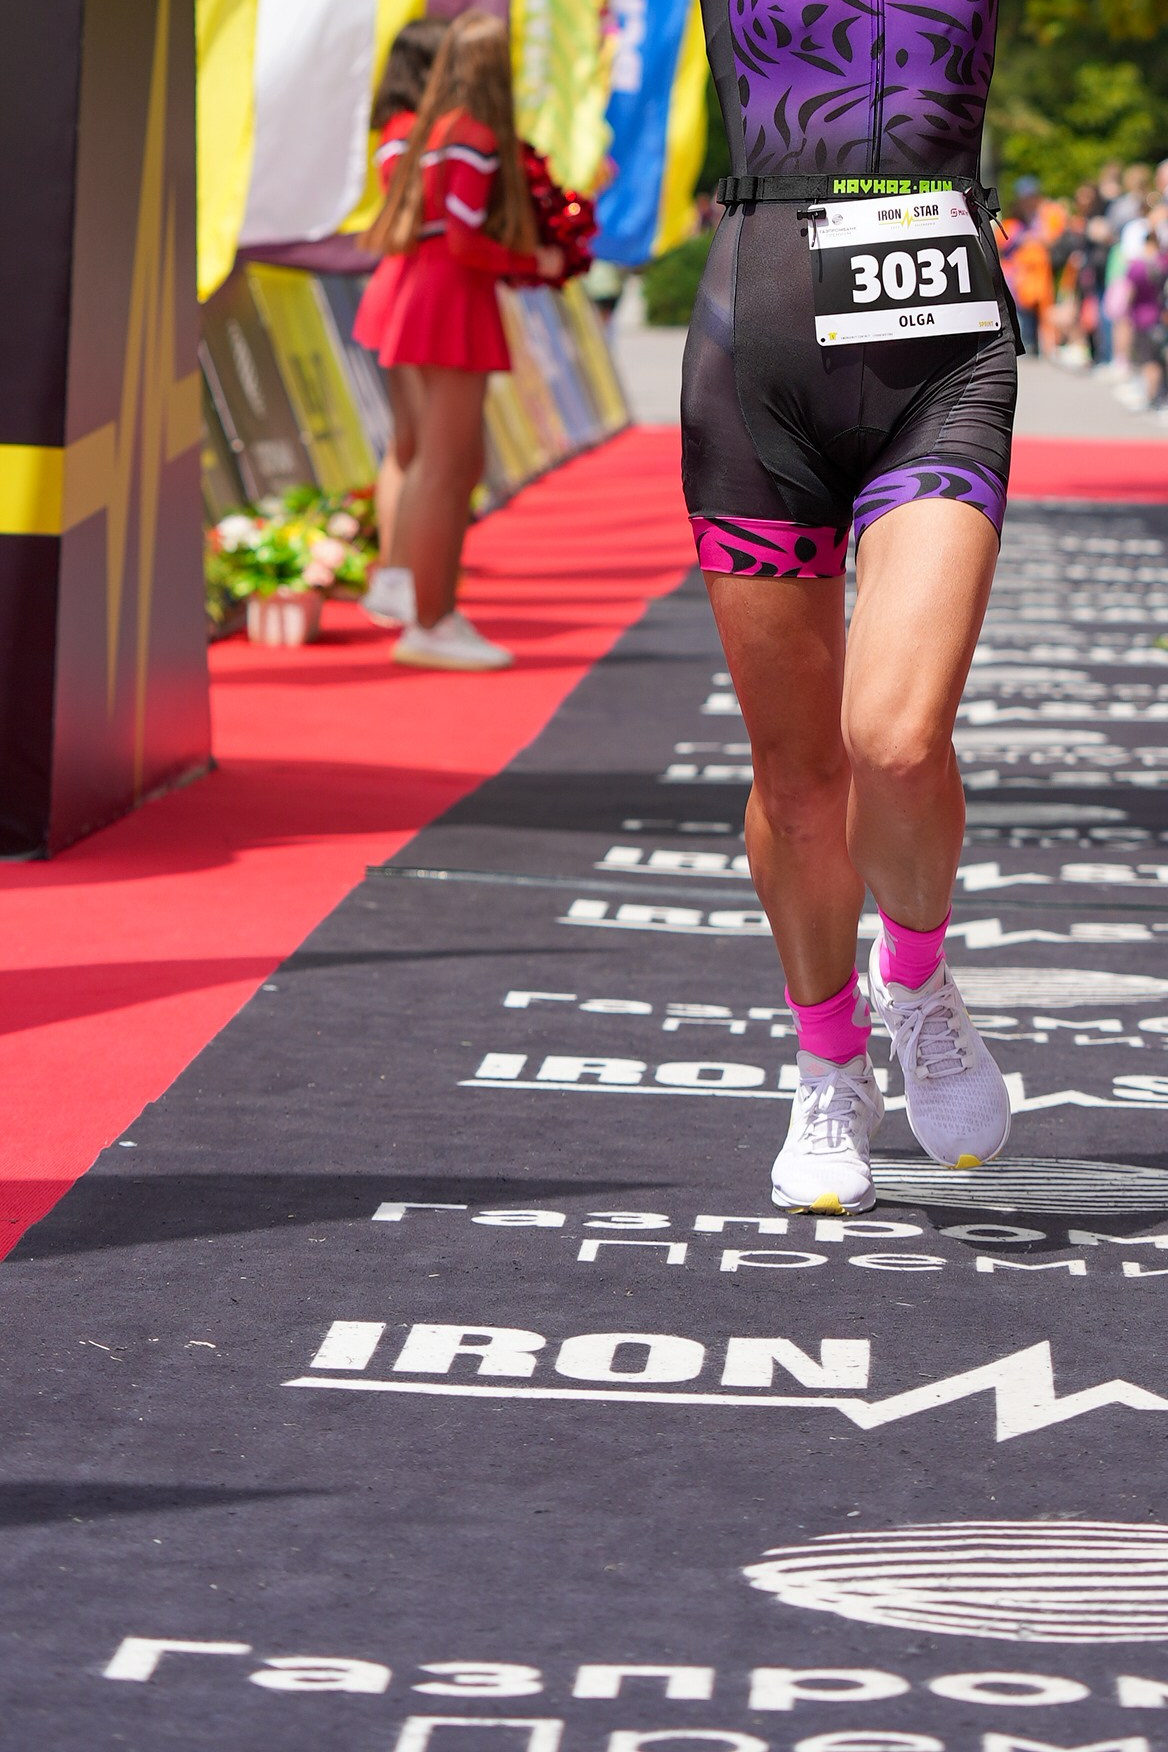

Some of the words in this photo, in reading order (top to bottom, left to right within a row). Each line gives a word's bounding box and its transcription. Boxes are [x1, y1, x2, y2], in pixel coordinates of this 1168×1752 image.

[877, 208, 902, 222] IRON
[914, 204, 940, 218] STAR
[851, 246, 971, 304] 3031
[899, 312, 935, 328] OLGA
[310, 1320, 871, 1390] IRON
